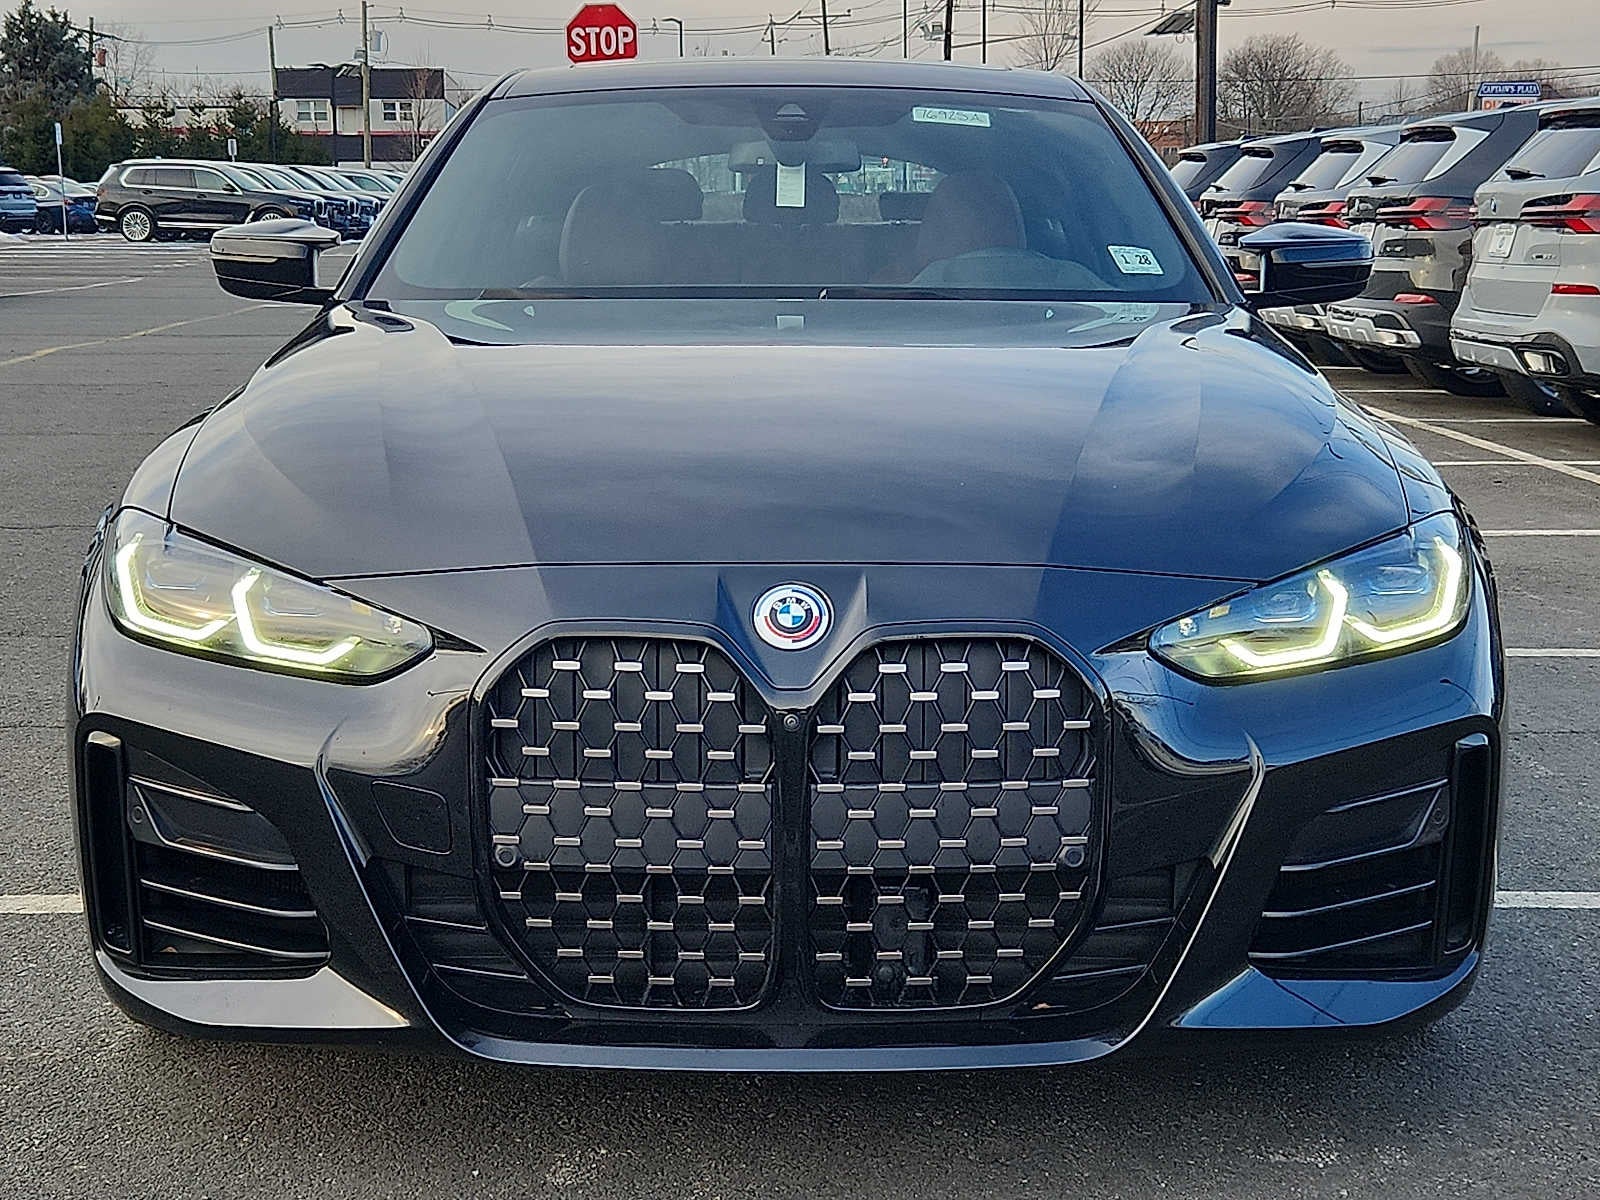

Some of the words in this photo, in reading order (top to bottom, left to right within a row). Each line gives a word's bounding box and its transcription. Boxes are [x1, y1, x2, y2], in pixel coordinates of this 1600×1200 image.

[570, 26, 634, 57] STOP
[1135, 254, 1152, 265] 28
[772, 597, 812, 611] BMW
